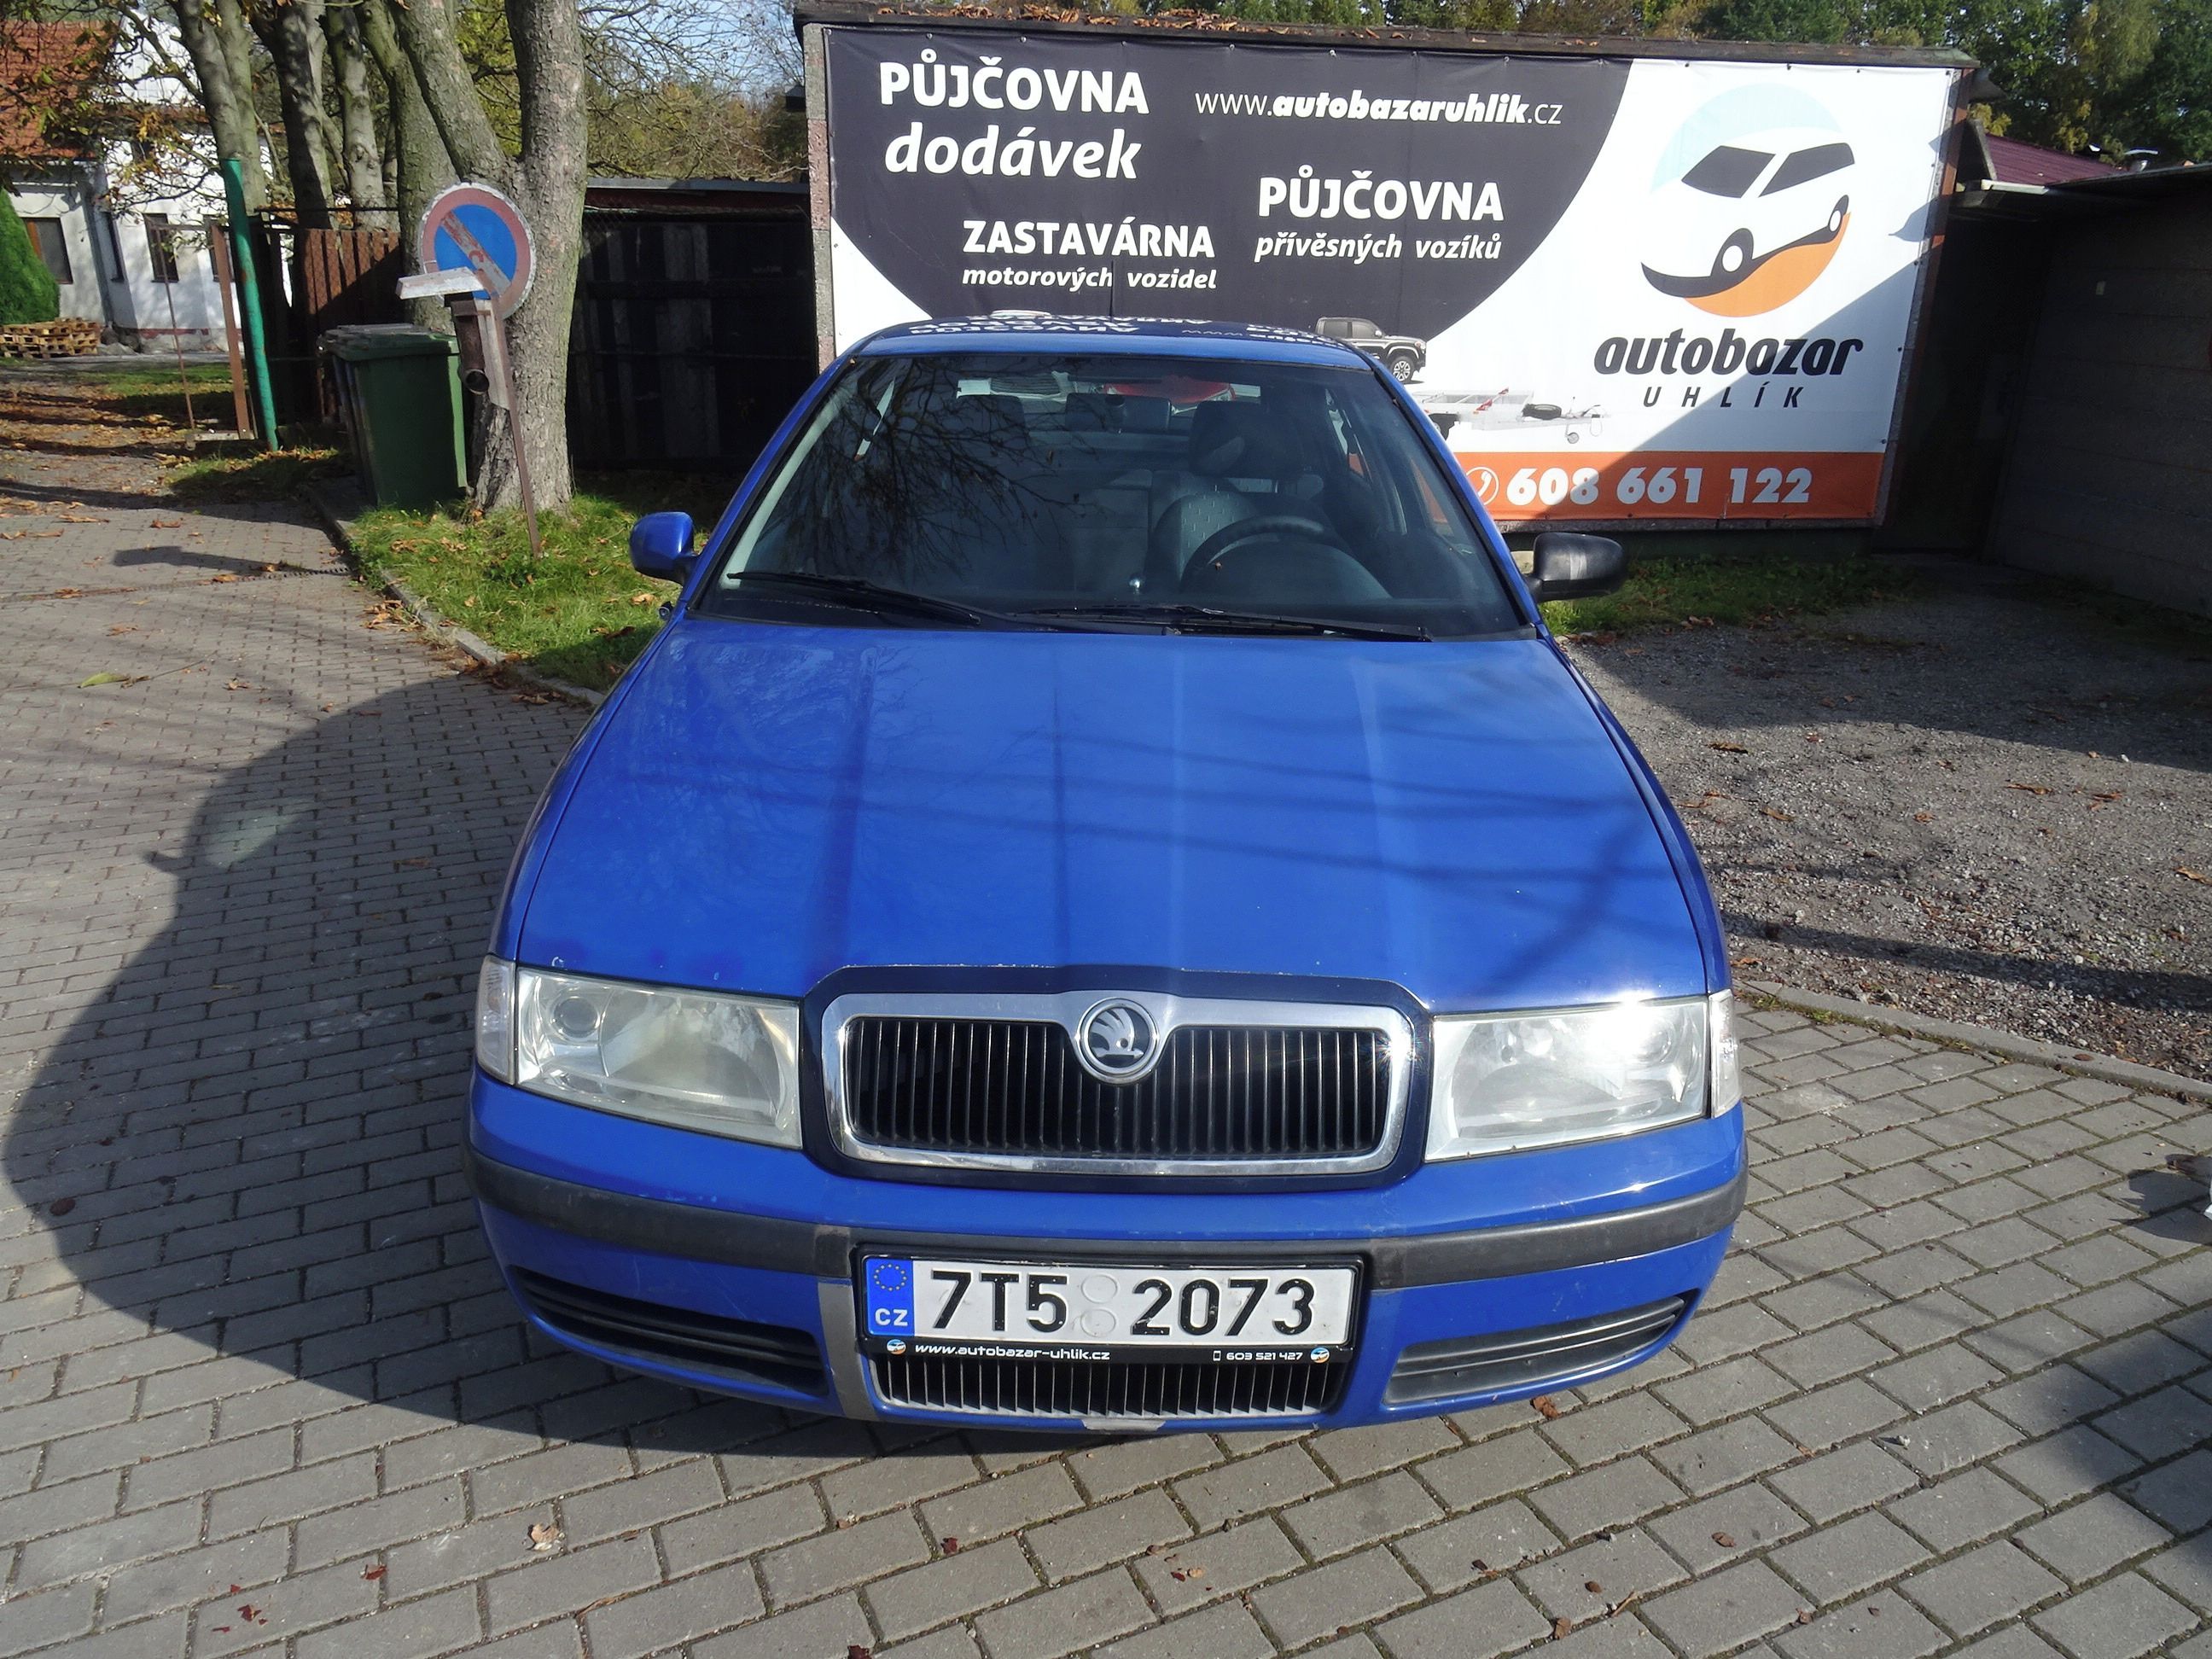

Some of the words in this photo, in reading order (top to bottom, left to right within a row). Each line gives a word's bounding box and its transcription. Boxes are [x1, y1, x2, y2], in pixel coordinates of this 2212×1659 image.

[880, 49, 1150, 114] PŮJČOVNA
[1195, 90, 1563, 125] www.autobazaruhlik.cz
[884, 121, 1142, 179] dodávek
[1259, 164, 1505, 221] PŮJČOVNA
[963, 216, 1215, 258] ZASTAVÁRNA
[1254, 231, 1402, 265] přívěsných
[1415, 232, 1502, 259] vozíků
[963, 267, 1113, 292] motorových
[1127, 269, 1217, 289] vozidel
[1594, 328, 1863, 376] autobazar
[1644, 381, 1805, 407] UHLÍK
[1506, 467, 1599, 506] 608
[1616, 467, 1703, 505] 661
[1728, 468, 1813, 504] 122
[875, 1308, 908, 1327] CZ
[931, 1269, 1068, 1333] 7T5
[1132, 1278, 1314, 1336] 2073
[915, 1343, 1109, 1360] www.autobazar-uhlik.cz
[1226, 1352, 1252, 1360] 603
[1255, 1352, 1276, 1360] 521
[1279, 1352, 1303, 1360] 427
